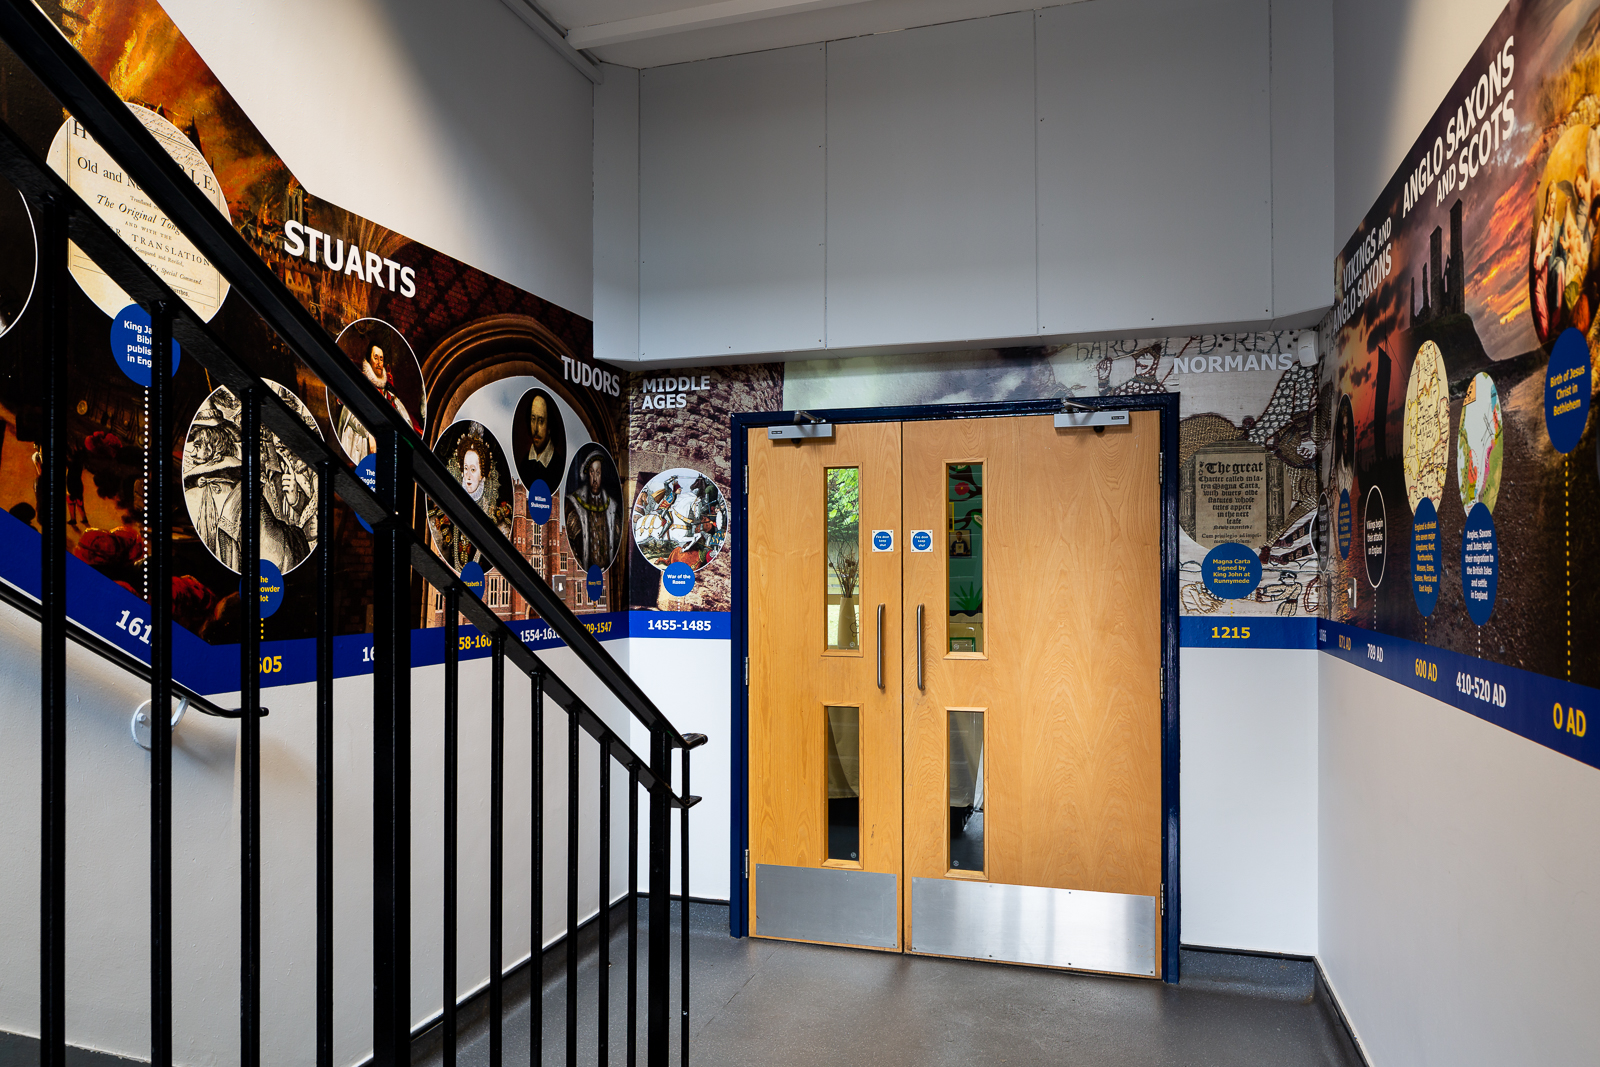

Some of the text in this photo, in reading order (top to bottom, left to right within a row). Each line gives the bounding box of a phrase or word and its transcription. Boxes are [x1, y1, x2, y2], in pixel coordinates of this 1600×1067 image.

[1403, 35, 1514, 218] ANGLO SAXONS
[1436, 89, 1514, 207] AND SCOTS
[77, 156, 122, 183] Old and
[97, 194, 180, 236] The Original Tong
[141, 226, 156, 235] WITH
[132, 234, 211, 267] TRANSLATION
[284, 220, 416, 298] STUARTS
[1343, 217, 1391, 292] VIKINGS AND
[1332, 243, 1392, 336] ANGLO SAXONS
[124, 320, 142, 333] King
[137, 334, 152, 345] Bibl
[127, 344, 152, 355] publis
[127, 354, 135, 362] in
[1173, 354, 1293, 374] NORMANS
[561, 355, 620, 397] TUDORS
[642, 376, 710, 393] MIDDLE
[1550, 365, 1585, 387] Birth of Jesus
[1556, 383, 1578, 400] Christ in
[642, 394, 686, 409] AGES
[1554, 399, 1581, 416] Bethlehem
[1205, 462, 1263, 475] The great
[1482, 540, 1492, 552] begin
[1474, 554, 1489, 564] migration
[1490, 554, 1494, 562] to
[1473, 566, 1483, 574] British
[1484, 566, 1492, 575] Isles
[1475, 591, 1488, 601] England
[116, 610, 152, 646] 161
[584, 622, 612, 634] 09-1547
[648, 620, 711, 631] 1455-1485
[1212, 626, 1250, 639] 1215
[459, 634, 492, 650] 58-160
[1346, 637, 1351, 650] AD
[1367, 643, 1383, 662] 789 AD
[259, 656, 282, 674] 05
[1415, 658, 1438, 682] 600 AD
[1456, 672, 1506, 708] 410-520 AD
[1566, 707, 1586, 737] AD
